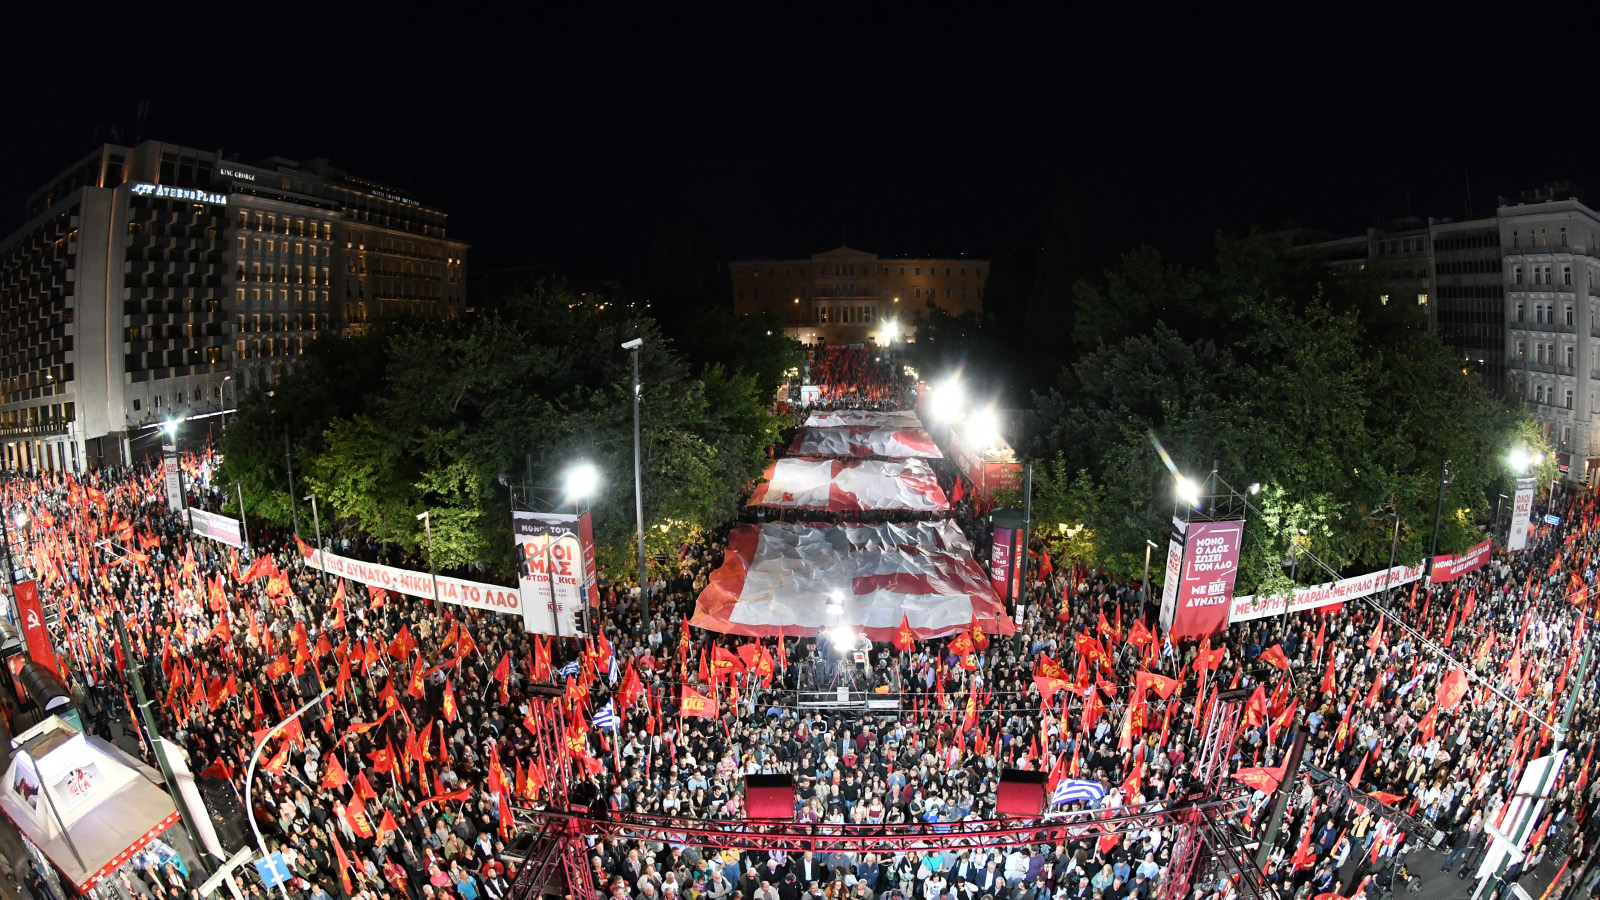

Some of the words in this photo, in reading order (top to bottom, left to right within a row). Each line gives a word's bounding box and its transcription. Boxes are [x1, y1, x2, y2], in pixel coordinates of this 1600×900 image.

[220, 168, 233, 177] KING
[234, 171, 255, 181] GEORGE
[1197, 537, 1224, 546] ΜΟΝΟ
[1195, 546, 1203, 555] Ο
[1204, 545, 1229, 554] ΛΑΟΣ
[1195, 554, 1222, 563] ΣΩΖΕΙ
[1434, 559, 1453, 569] ΜΟΝΟ
[529, 559, 572, 576] ΜΑΣ
[1194, 562, 1213, 571] ΤΟΝ
[1214, 561, 1232, 570] ΛΑΟ
[327, 556, 344, 572] ΠΙΟ
[347, 562, 390, 585] ΔΥΝΑΤΟ
[400, 574, 432, 594] ΝΙΚΗ
[461, 584, 480, 602] ΤΟ
[485, 589, 518, 608] ΛΑΟ
[1191, 585, 1207, 595] ΜΕ
[1208, 583, 1226, 593] ΚΚΕ
[1186, 595, 1226, 607] ΔΥΝΑΤΟ
[1235, 602, 1251, 615] ΜΕ
